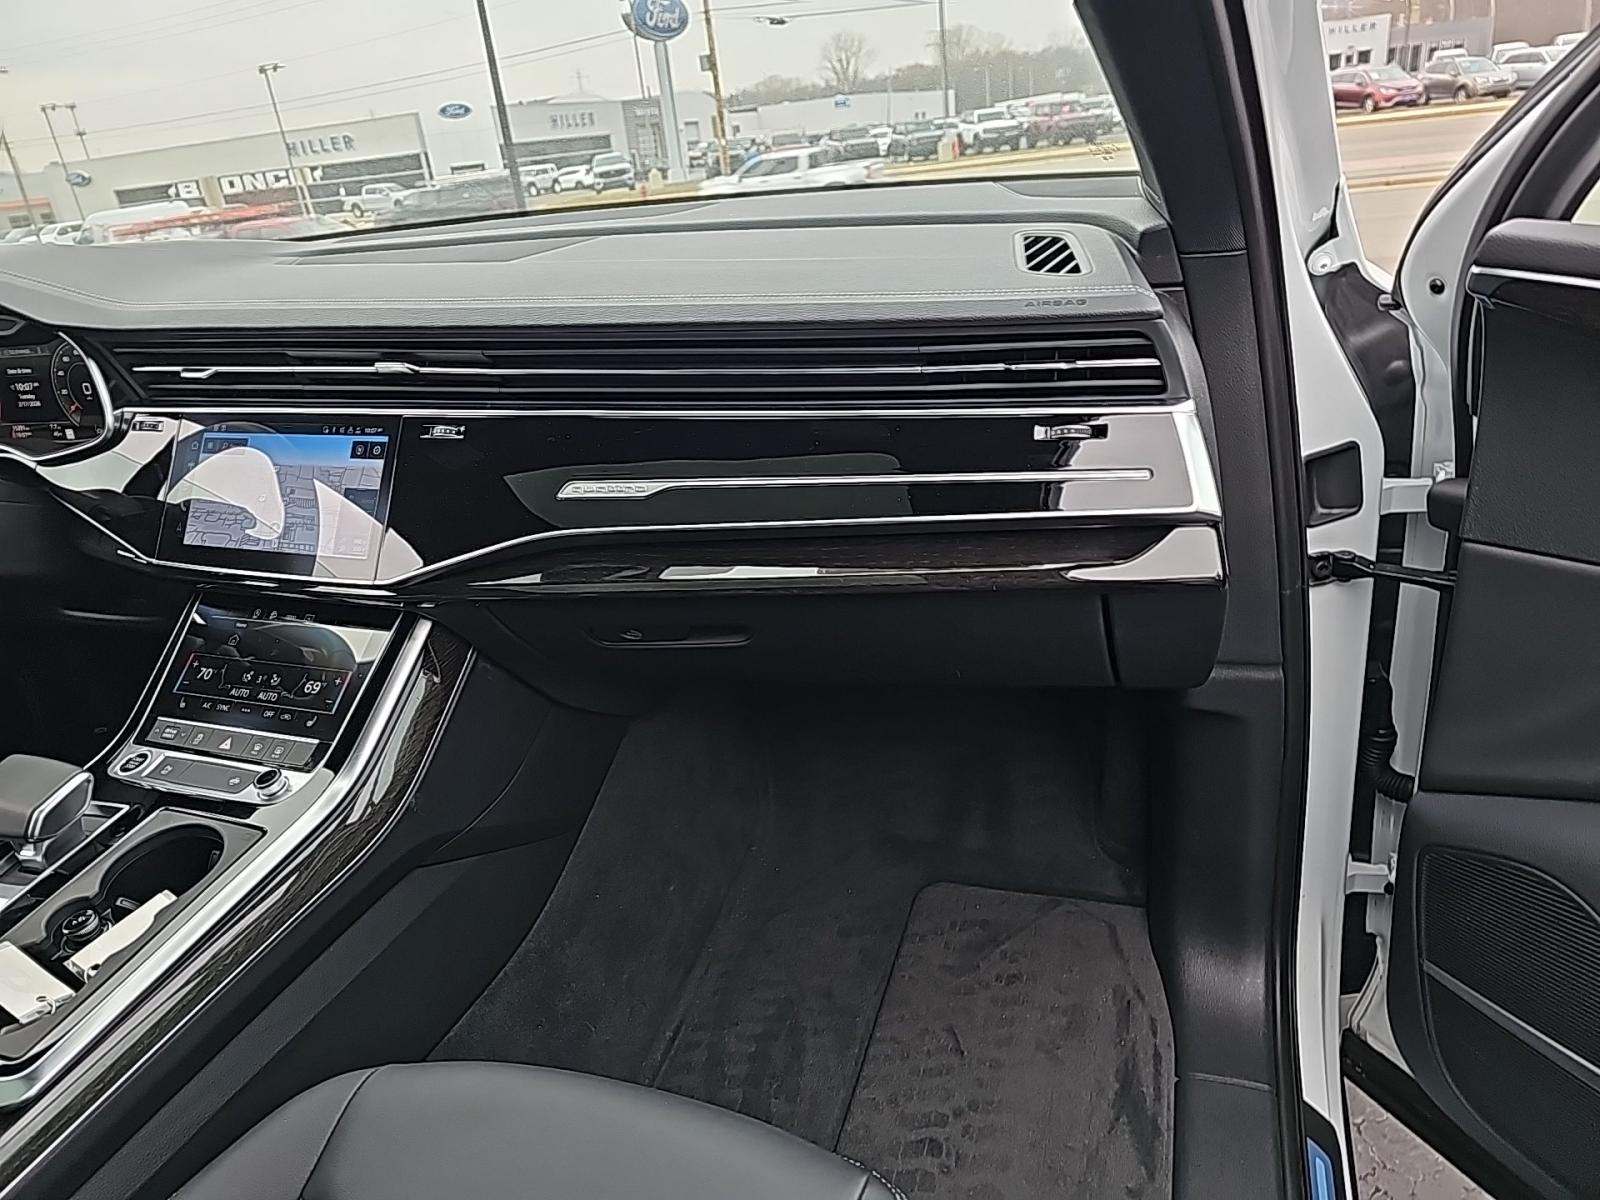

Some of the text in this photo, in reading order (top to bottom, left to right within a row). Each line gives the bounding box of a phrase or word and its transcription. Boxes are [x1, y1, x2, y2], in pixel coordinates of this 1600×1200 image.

[645, 0, 681, 29] Ford
[1024, 299, 1088, 308] AIRBAG
[197, 667, 213, 680] 70
[304, 681, 321, 694] 69
[229, 688, 278, 702] AUTO AUTO
